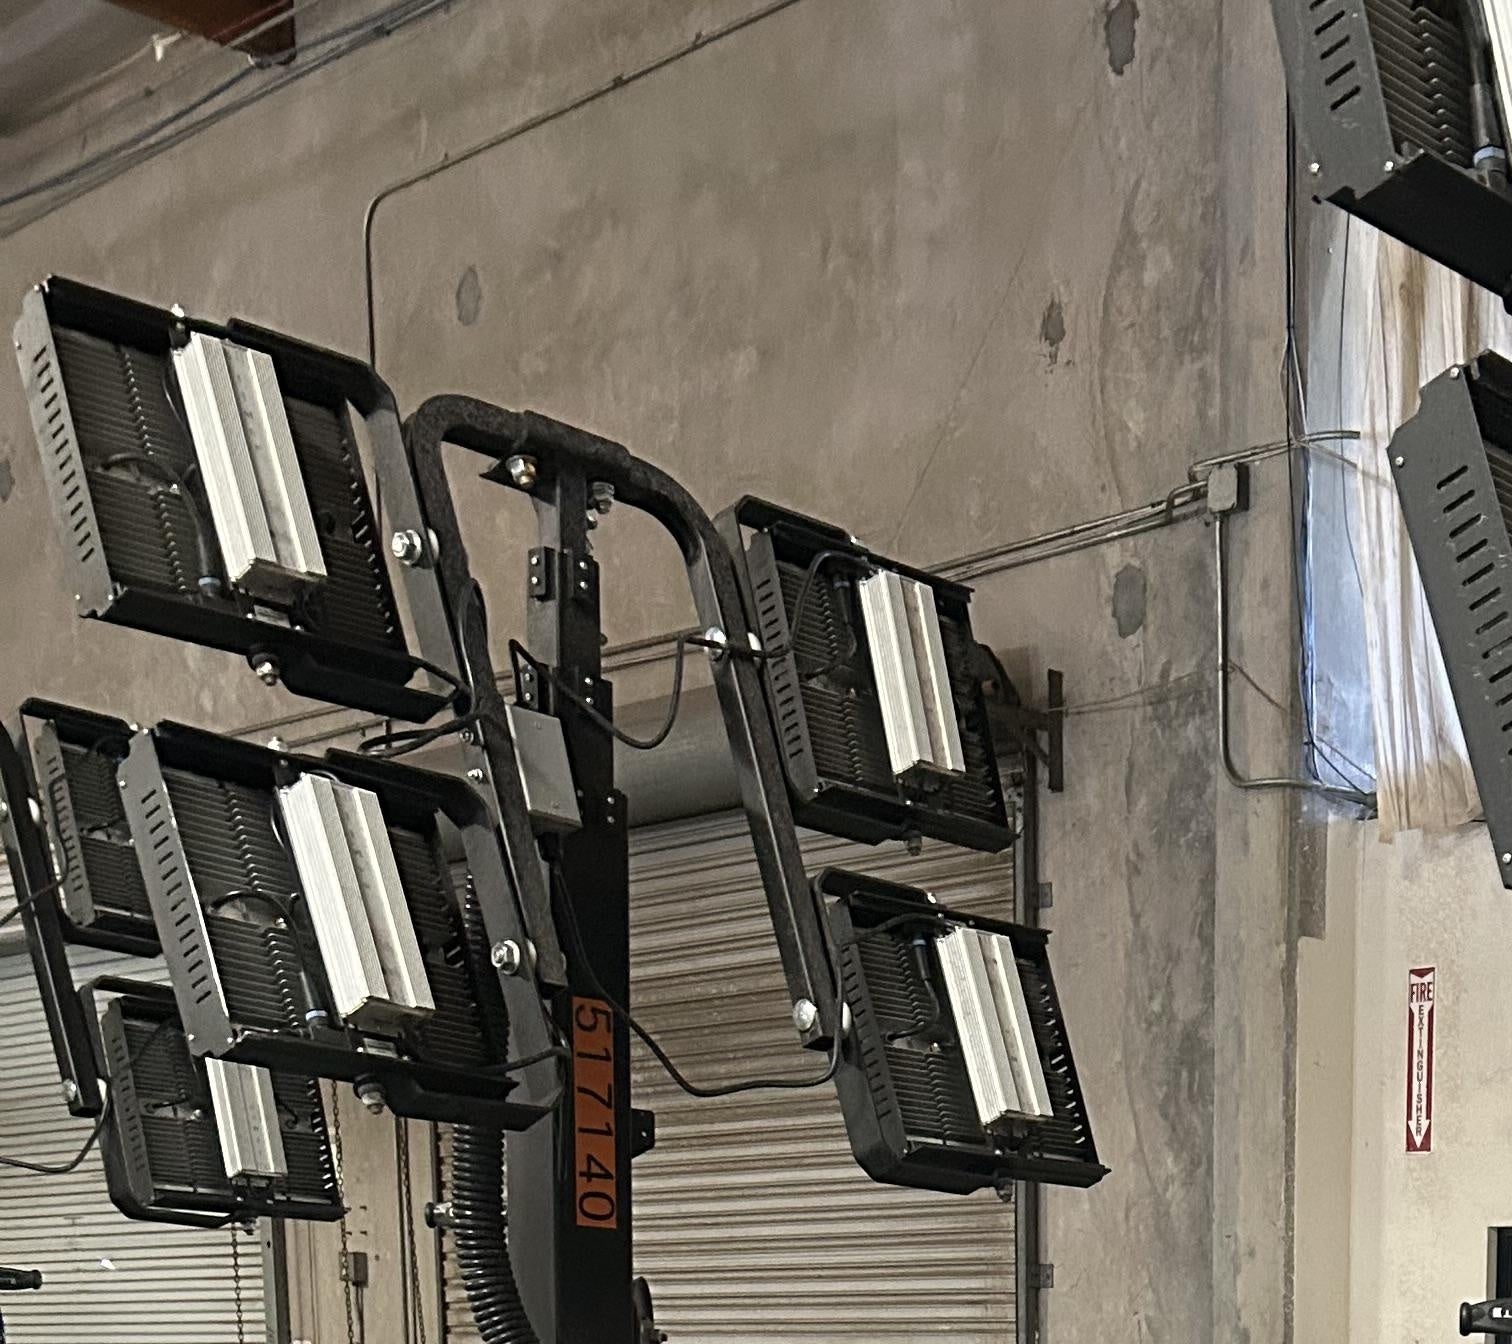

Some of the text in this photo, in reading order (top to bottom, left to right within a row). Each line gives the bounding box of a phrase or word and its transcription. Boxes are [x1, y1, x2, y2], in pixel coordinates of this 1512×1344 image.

[1410, 981, 1433, 1003] FIRE
[575, 1003, 615, 1222] 517140
[1415, 1004, 1425, 1137] EXTINGUISHER
